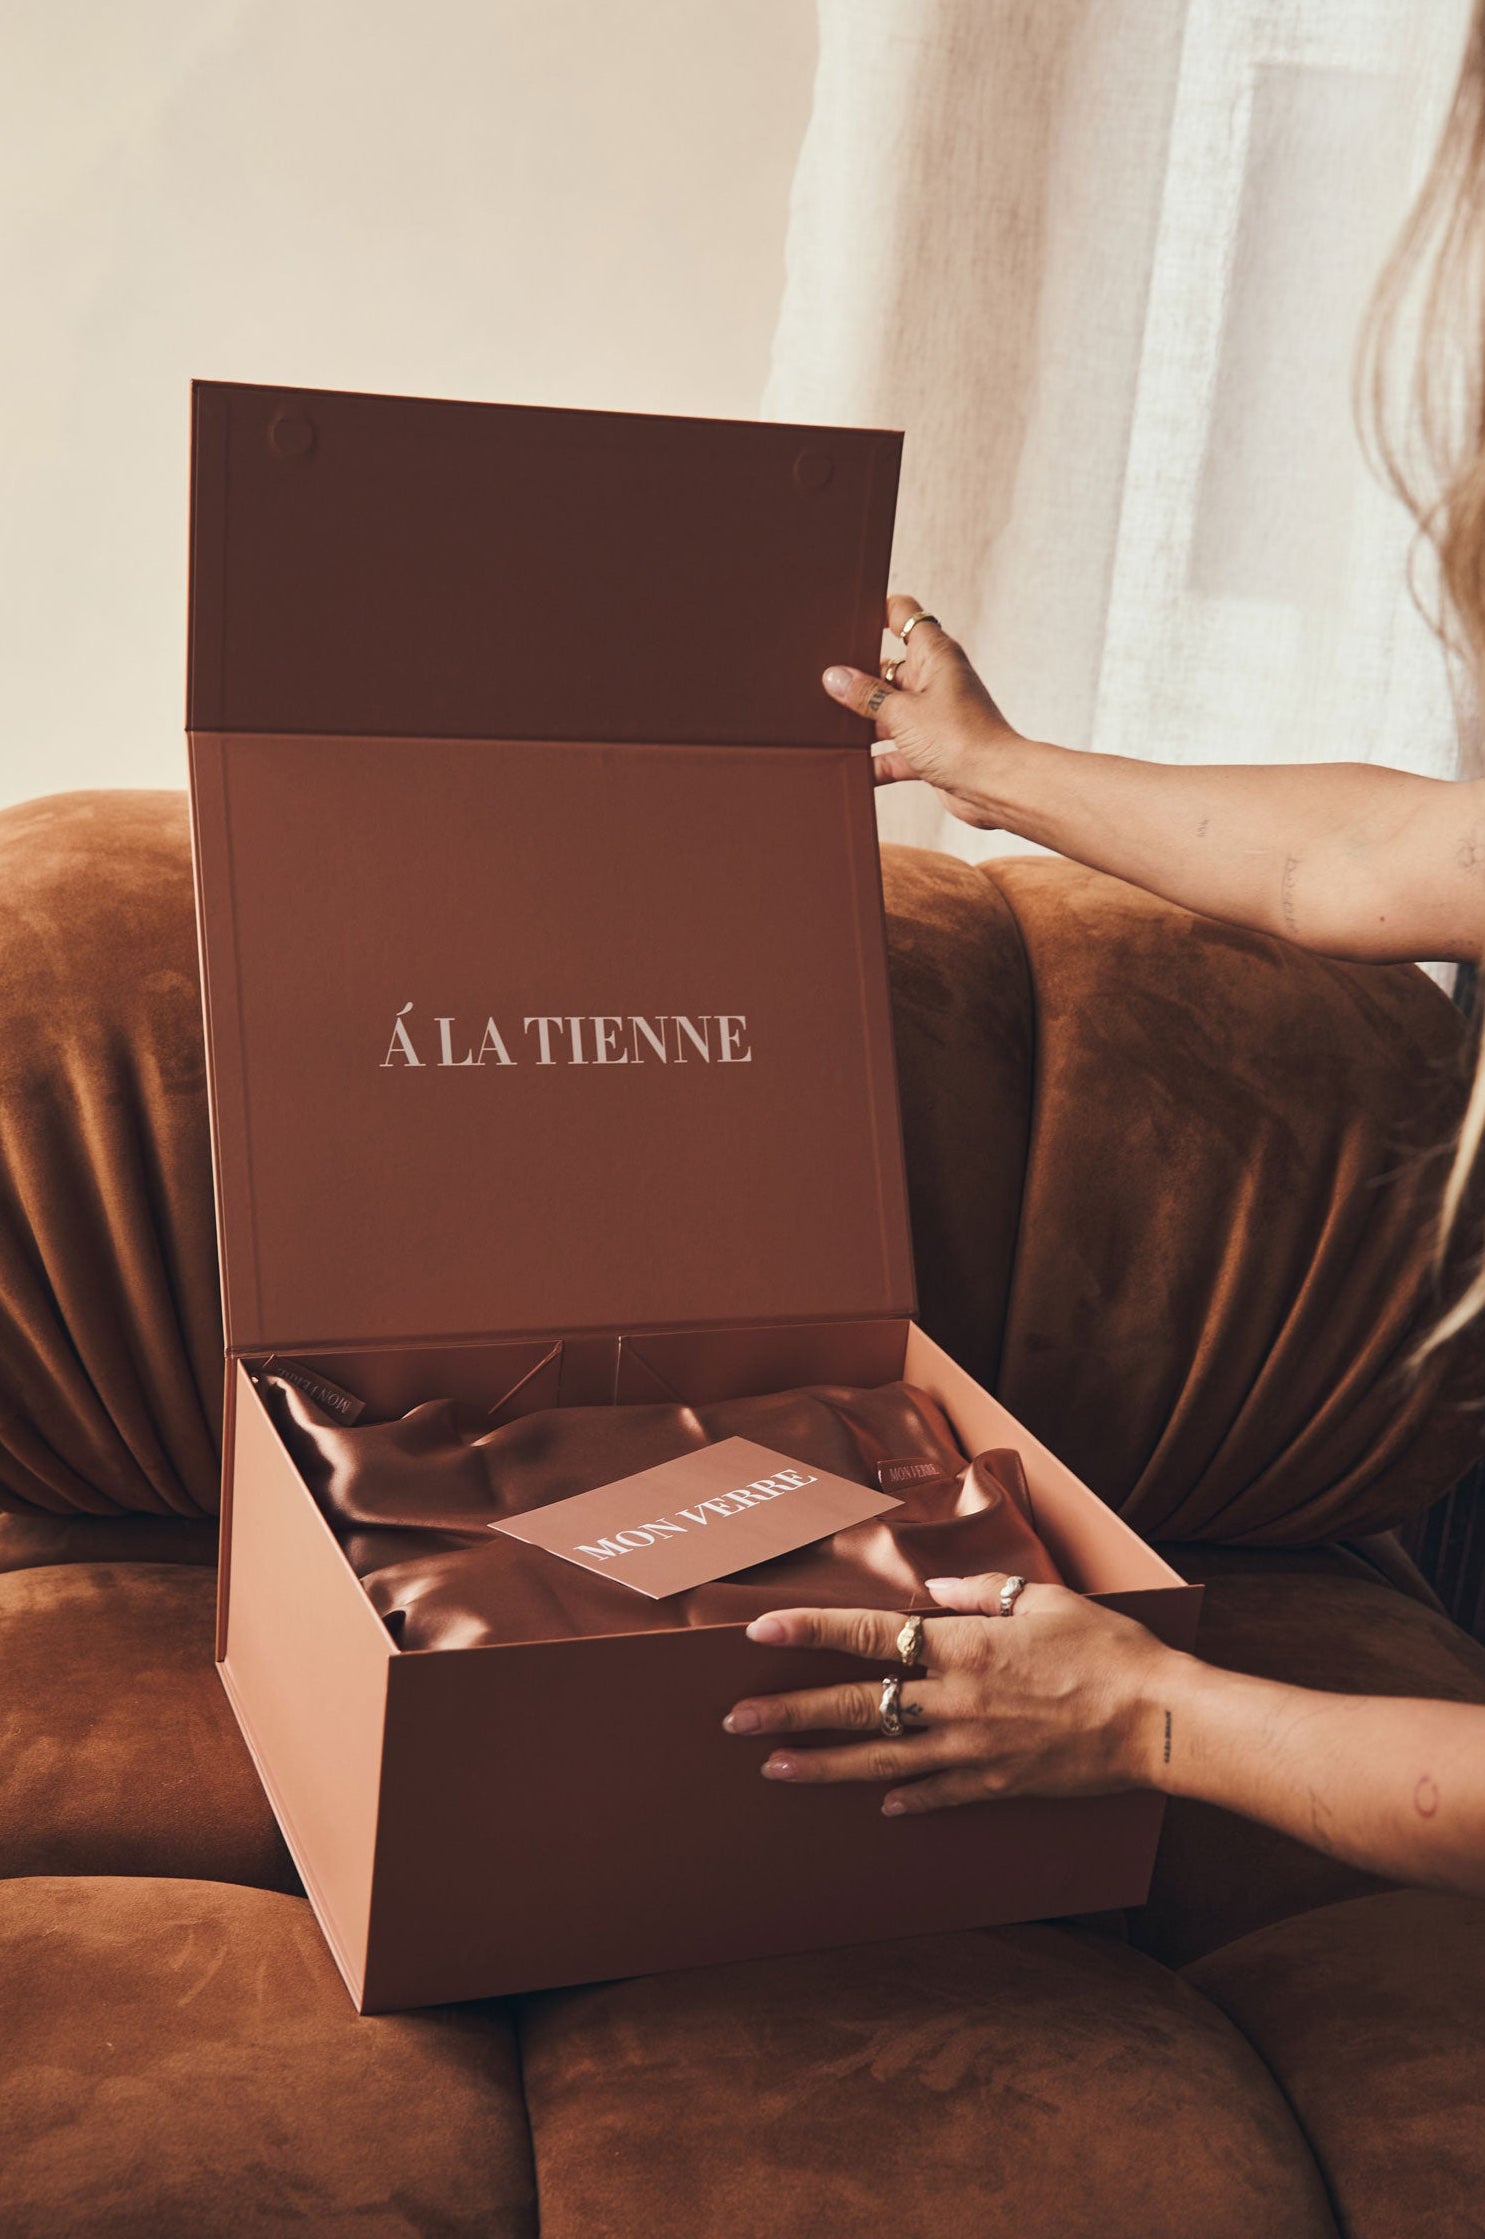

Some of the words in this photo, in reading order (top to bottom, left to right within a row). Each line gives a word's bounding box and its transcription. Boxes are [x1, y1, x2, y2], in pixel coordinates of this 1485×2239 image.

[379, 1001, 427, 1067] Á
[433, 1016, 518, 1066] LA
[523, 1014, 752, 1065] TIENNE
[318, 1387, 351, 1413] MON
[889, 1465, 912, 1481] MON
[573, 1517, 688, 1562] MON
[675, 1468, 818, 1526] VERRE
